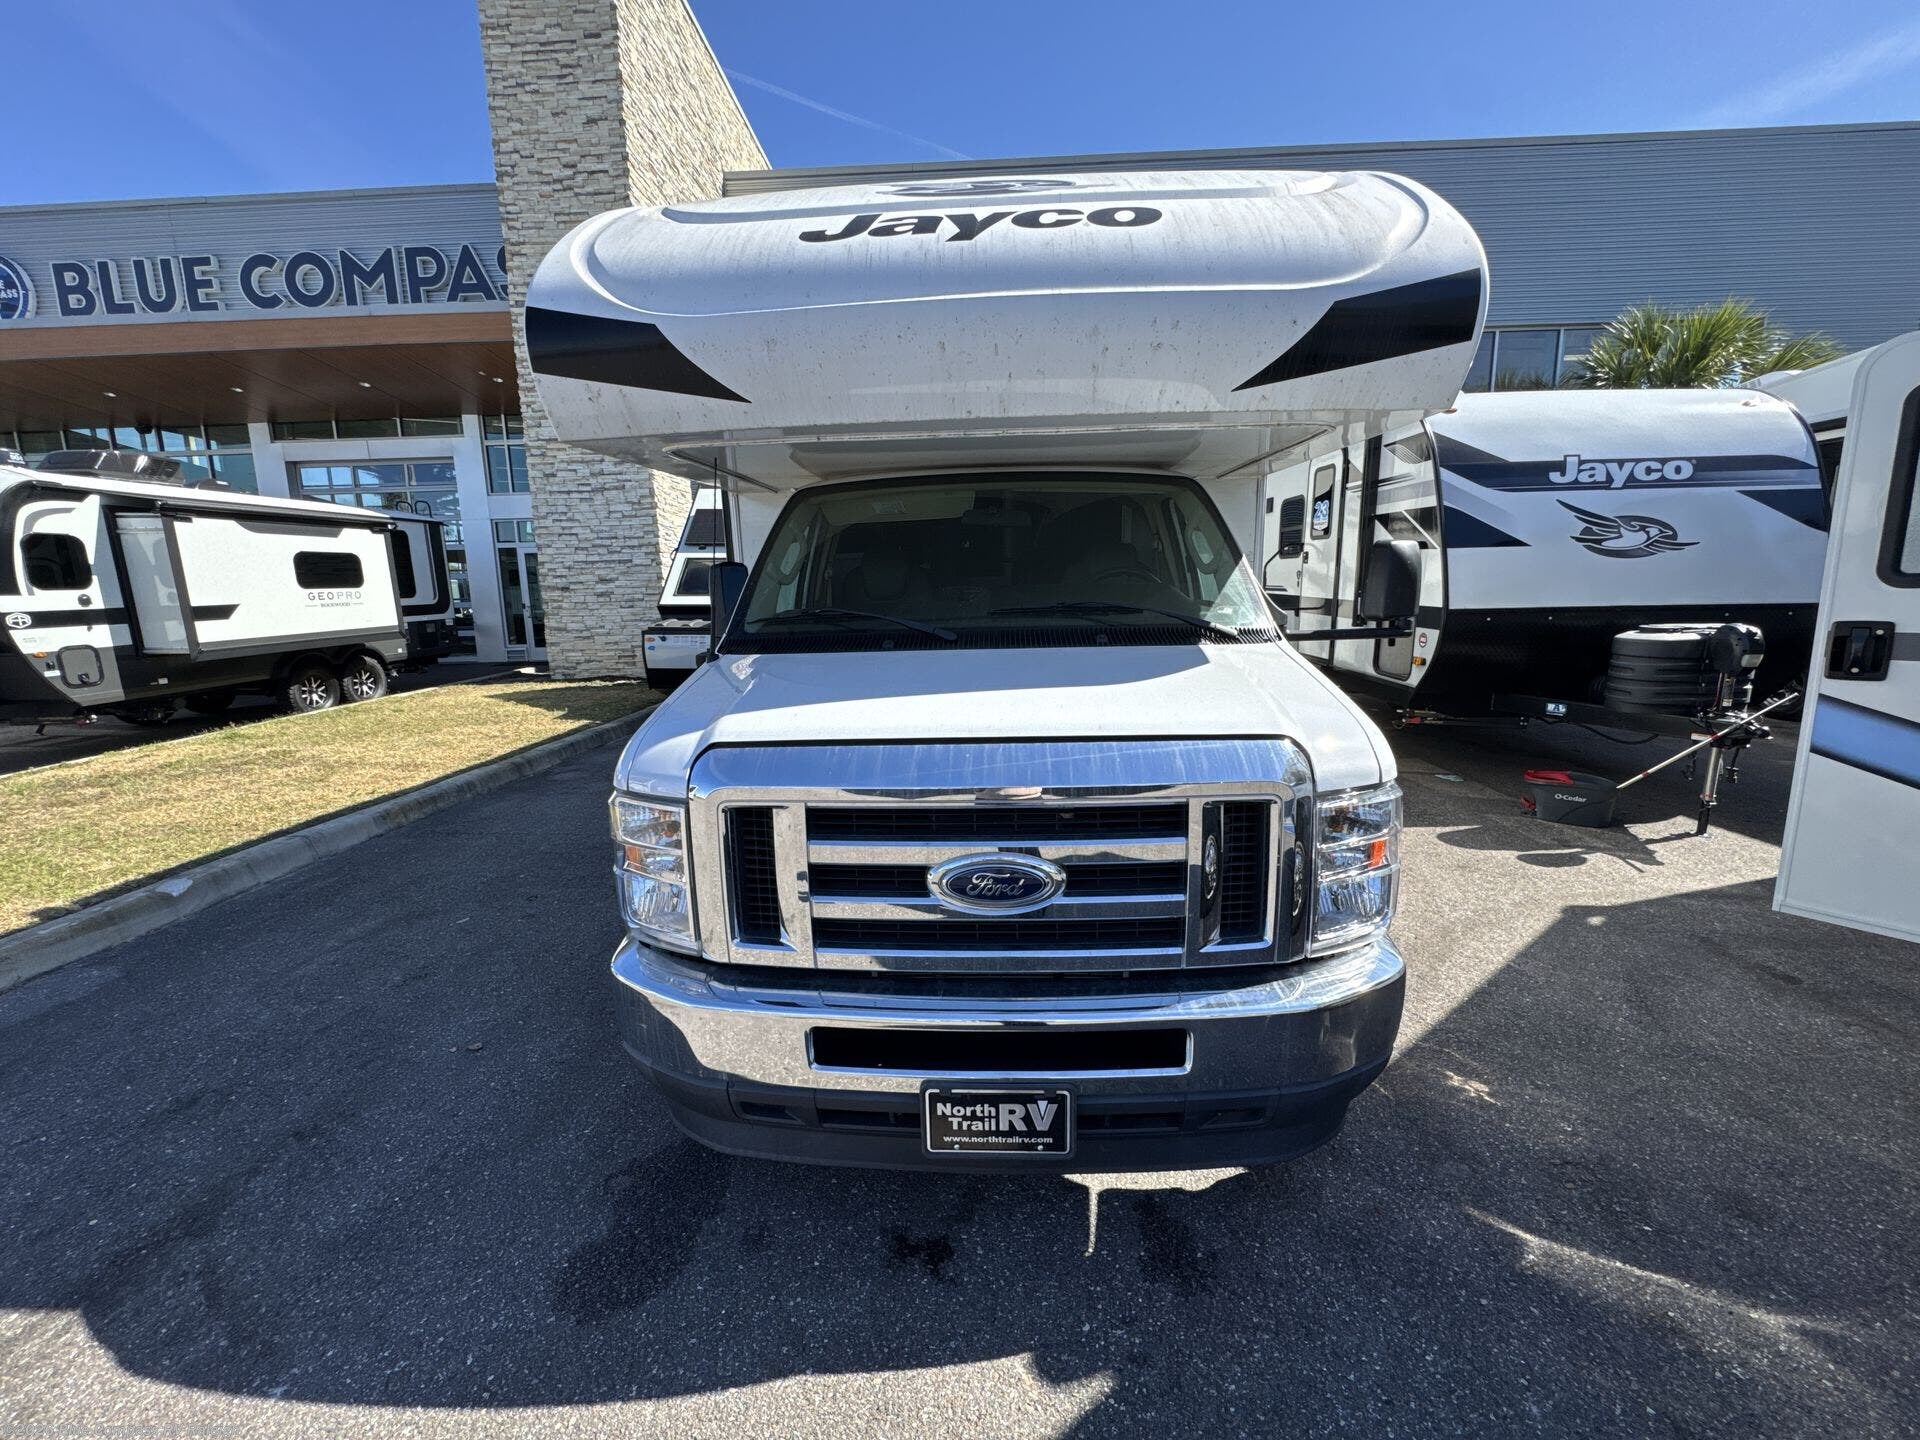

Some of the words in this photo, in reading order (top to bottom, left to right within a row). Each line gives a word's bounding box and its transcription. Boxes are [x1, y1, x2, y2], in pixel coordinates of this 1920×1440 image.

[799, 207, 1162, 242] Jayco
[52, 256, 220, 317] BLUE
[1549, 456, 1694, 488] Jayco
[966, 872, 1025, 896] Ford
[936, 1102, 996, 1117] North
[999, 1100, 1059, 1132] RV
[948, 1117, 997, 1131] Trail
[943, 1134, 1053, 1144] www.northtrailrv.com
